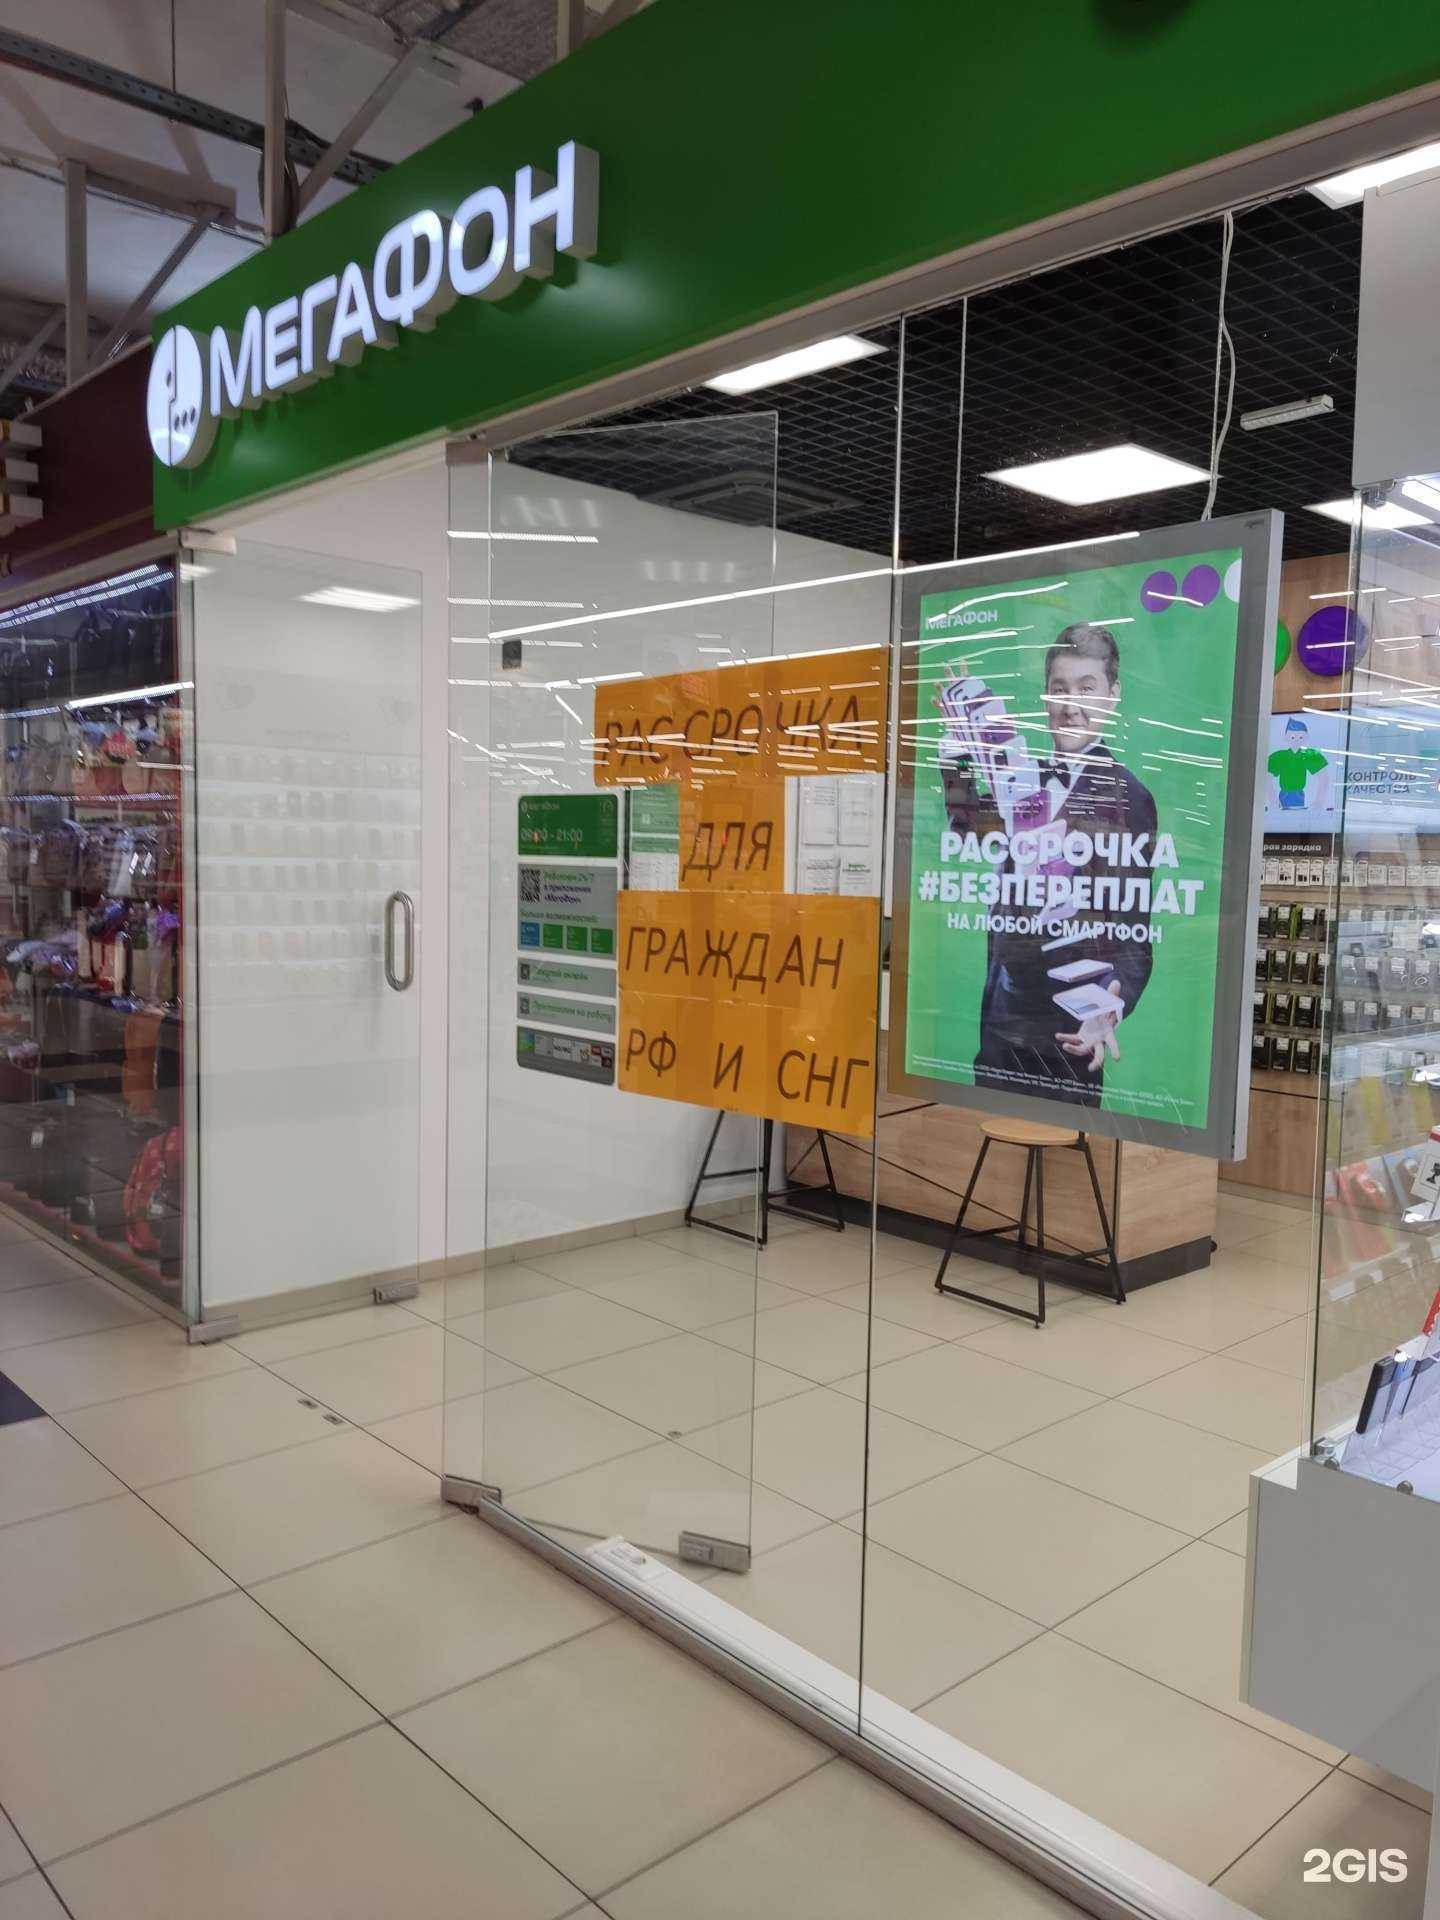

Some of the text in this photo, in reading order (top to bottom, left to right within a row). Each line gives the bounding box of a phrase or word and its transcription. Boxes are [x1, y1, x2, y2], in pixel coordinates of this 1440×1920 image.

[210, 139, 576, 417] МЕГАФОН
[601, 695, 862, 768] РАССРОЧКА
[681, 821, 774, 883] ДЛЯ
[939, 830, 1180, 869] РАССРОЧКА
[918, 869, 1205, 916] #БЕЗПЕРЕПЛАТ
[625, 926, 844, 995] ГРАЖДАН
[947, 912, 1163, 944] НА ЛЮБОЙ СМАРТФОН
[625, 1028, 677, 1077] РФ
[713, 1042, 744, 1092] И
[777, 1050, 870, 1109] СНГ
